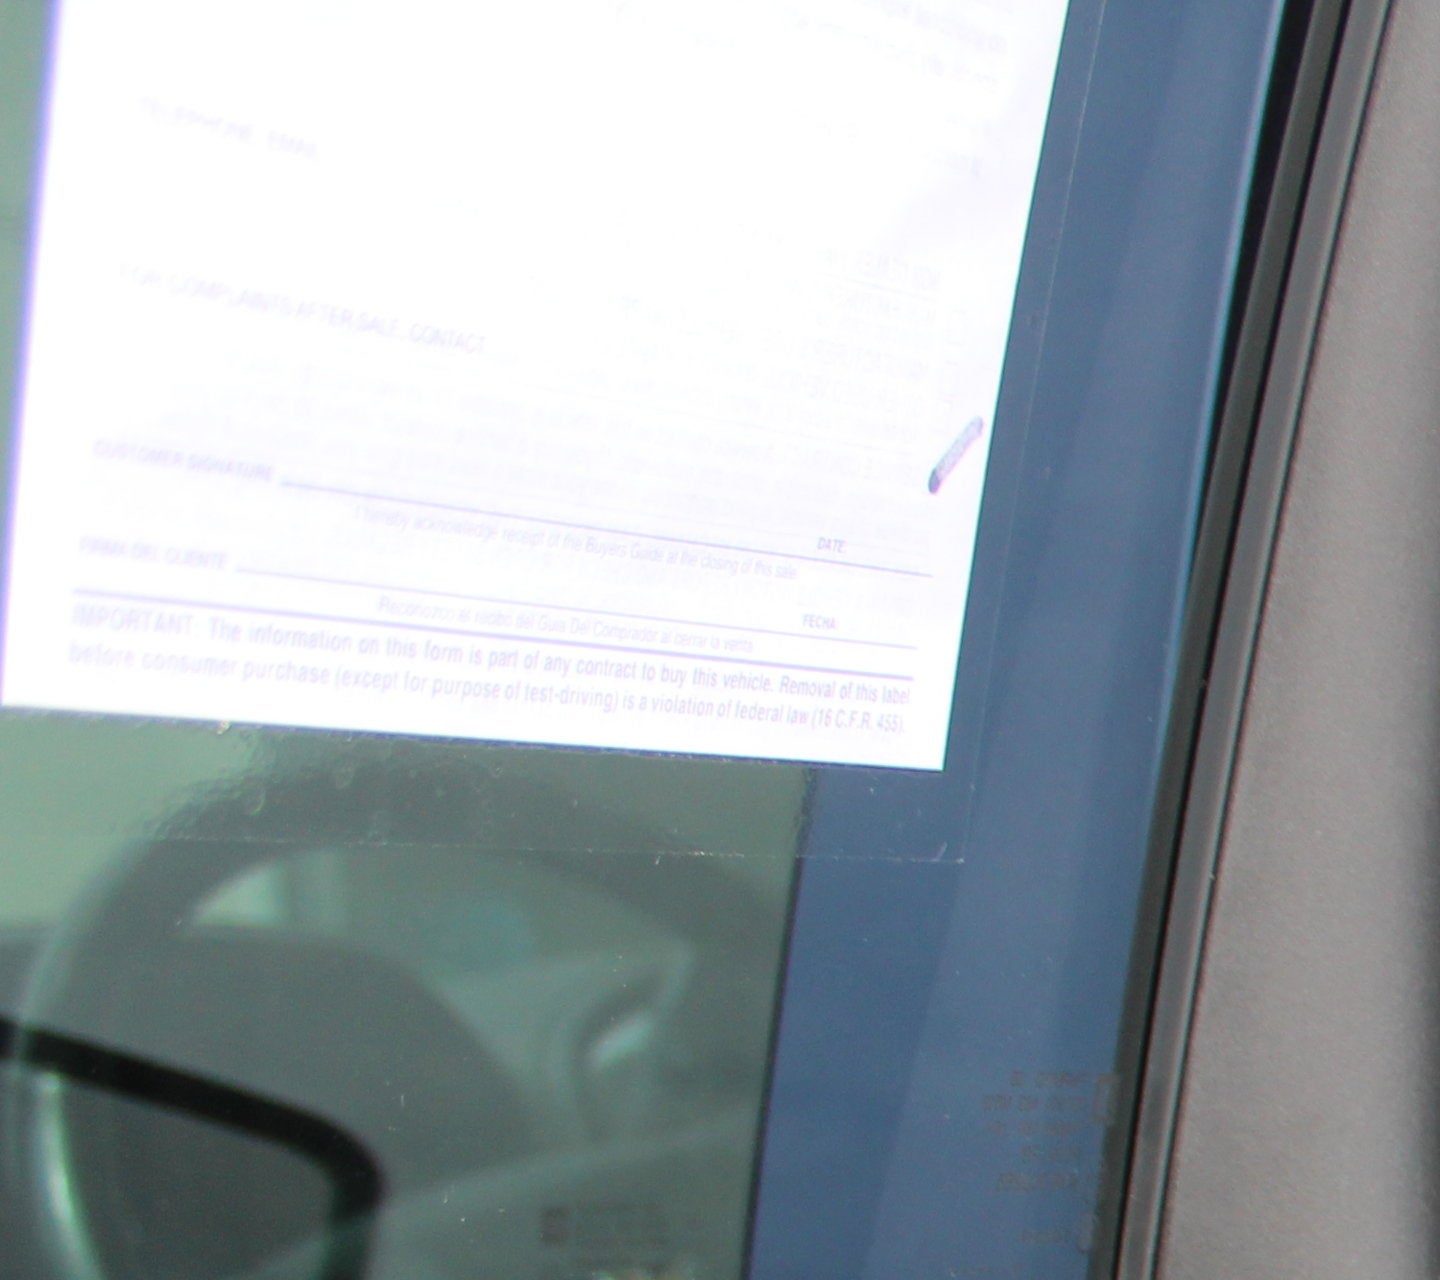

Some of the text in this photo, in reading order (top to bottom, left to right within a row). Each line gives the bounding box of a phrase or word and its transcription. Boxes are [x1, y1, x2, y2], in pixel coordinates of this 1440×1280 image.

[503, 527, 546, 549] receipt
[547, 532, 563, 549] of
[564, 534, 582, 550] the
[630, 543, 663, 563] Guide
[679, 552, 698, 567] the
[700, 555, 739, 576] closing
[754, 561, 772, 578] this
[209, 615, 243, 643] The
[248, 622, 351, 651] information
[358, 635, 379, 655] on
[386, 636, 417, 658] this
[424, 639, 464, 664] form
[468, 646, 483, 666] is
[487, 650, 519, 672] part
[523, 650, 540, 670] of
[543, 655, 571, 677] any
[576, 658, 637, 681] contract
[642, 662, 656, 681] to
[660, 662, 688, 688] buy
[692, 667, 718, 688] this
[723, 670, 773, 693] vehicle.
[779, 675, 837, 699] Removal
[839, 681, 854, 700] of
[855, 683, 878, 703] this
[882, 685, 910, 706] label
[593, 619, 658, 642] Comprador
[67, 639, 135, 667] before
[141, 651, 237, 677] consumer
[241, 660, 330, 686] purchase
[335, 667, 398, 693] (except
[403, 670, 427, 692] for
[432, 676, 501, 701] purpose
[504, 681, 520, 700] of
[525, 683, 618, 713] test-driving)
[623, 691, 635, 710] is
[652, 693, 714, 716] violation
[717, 699, 733, 717] of
[734, 700, 784, 722] federal
[786, 705, 809, 725] law
[811, 707, 832, 729] (16
